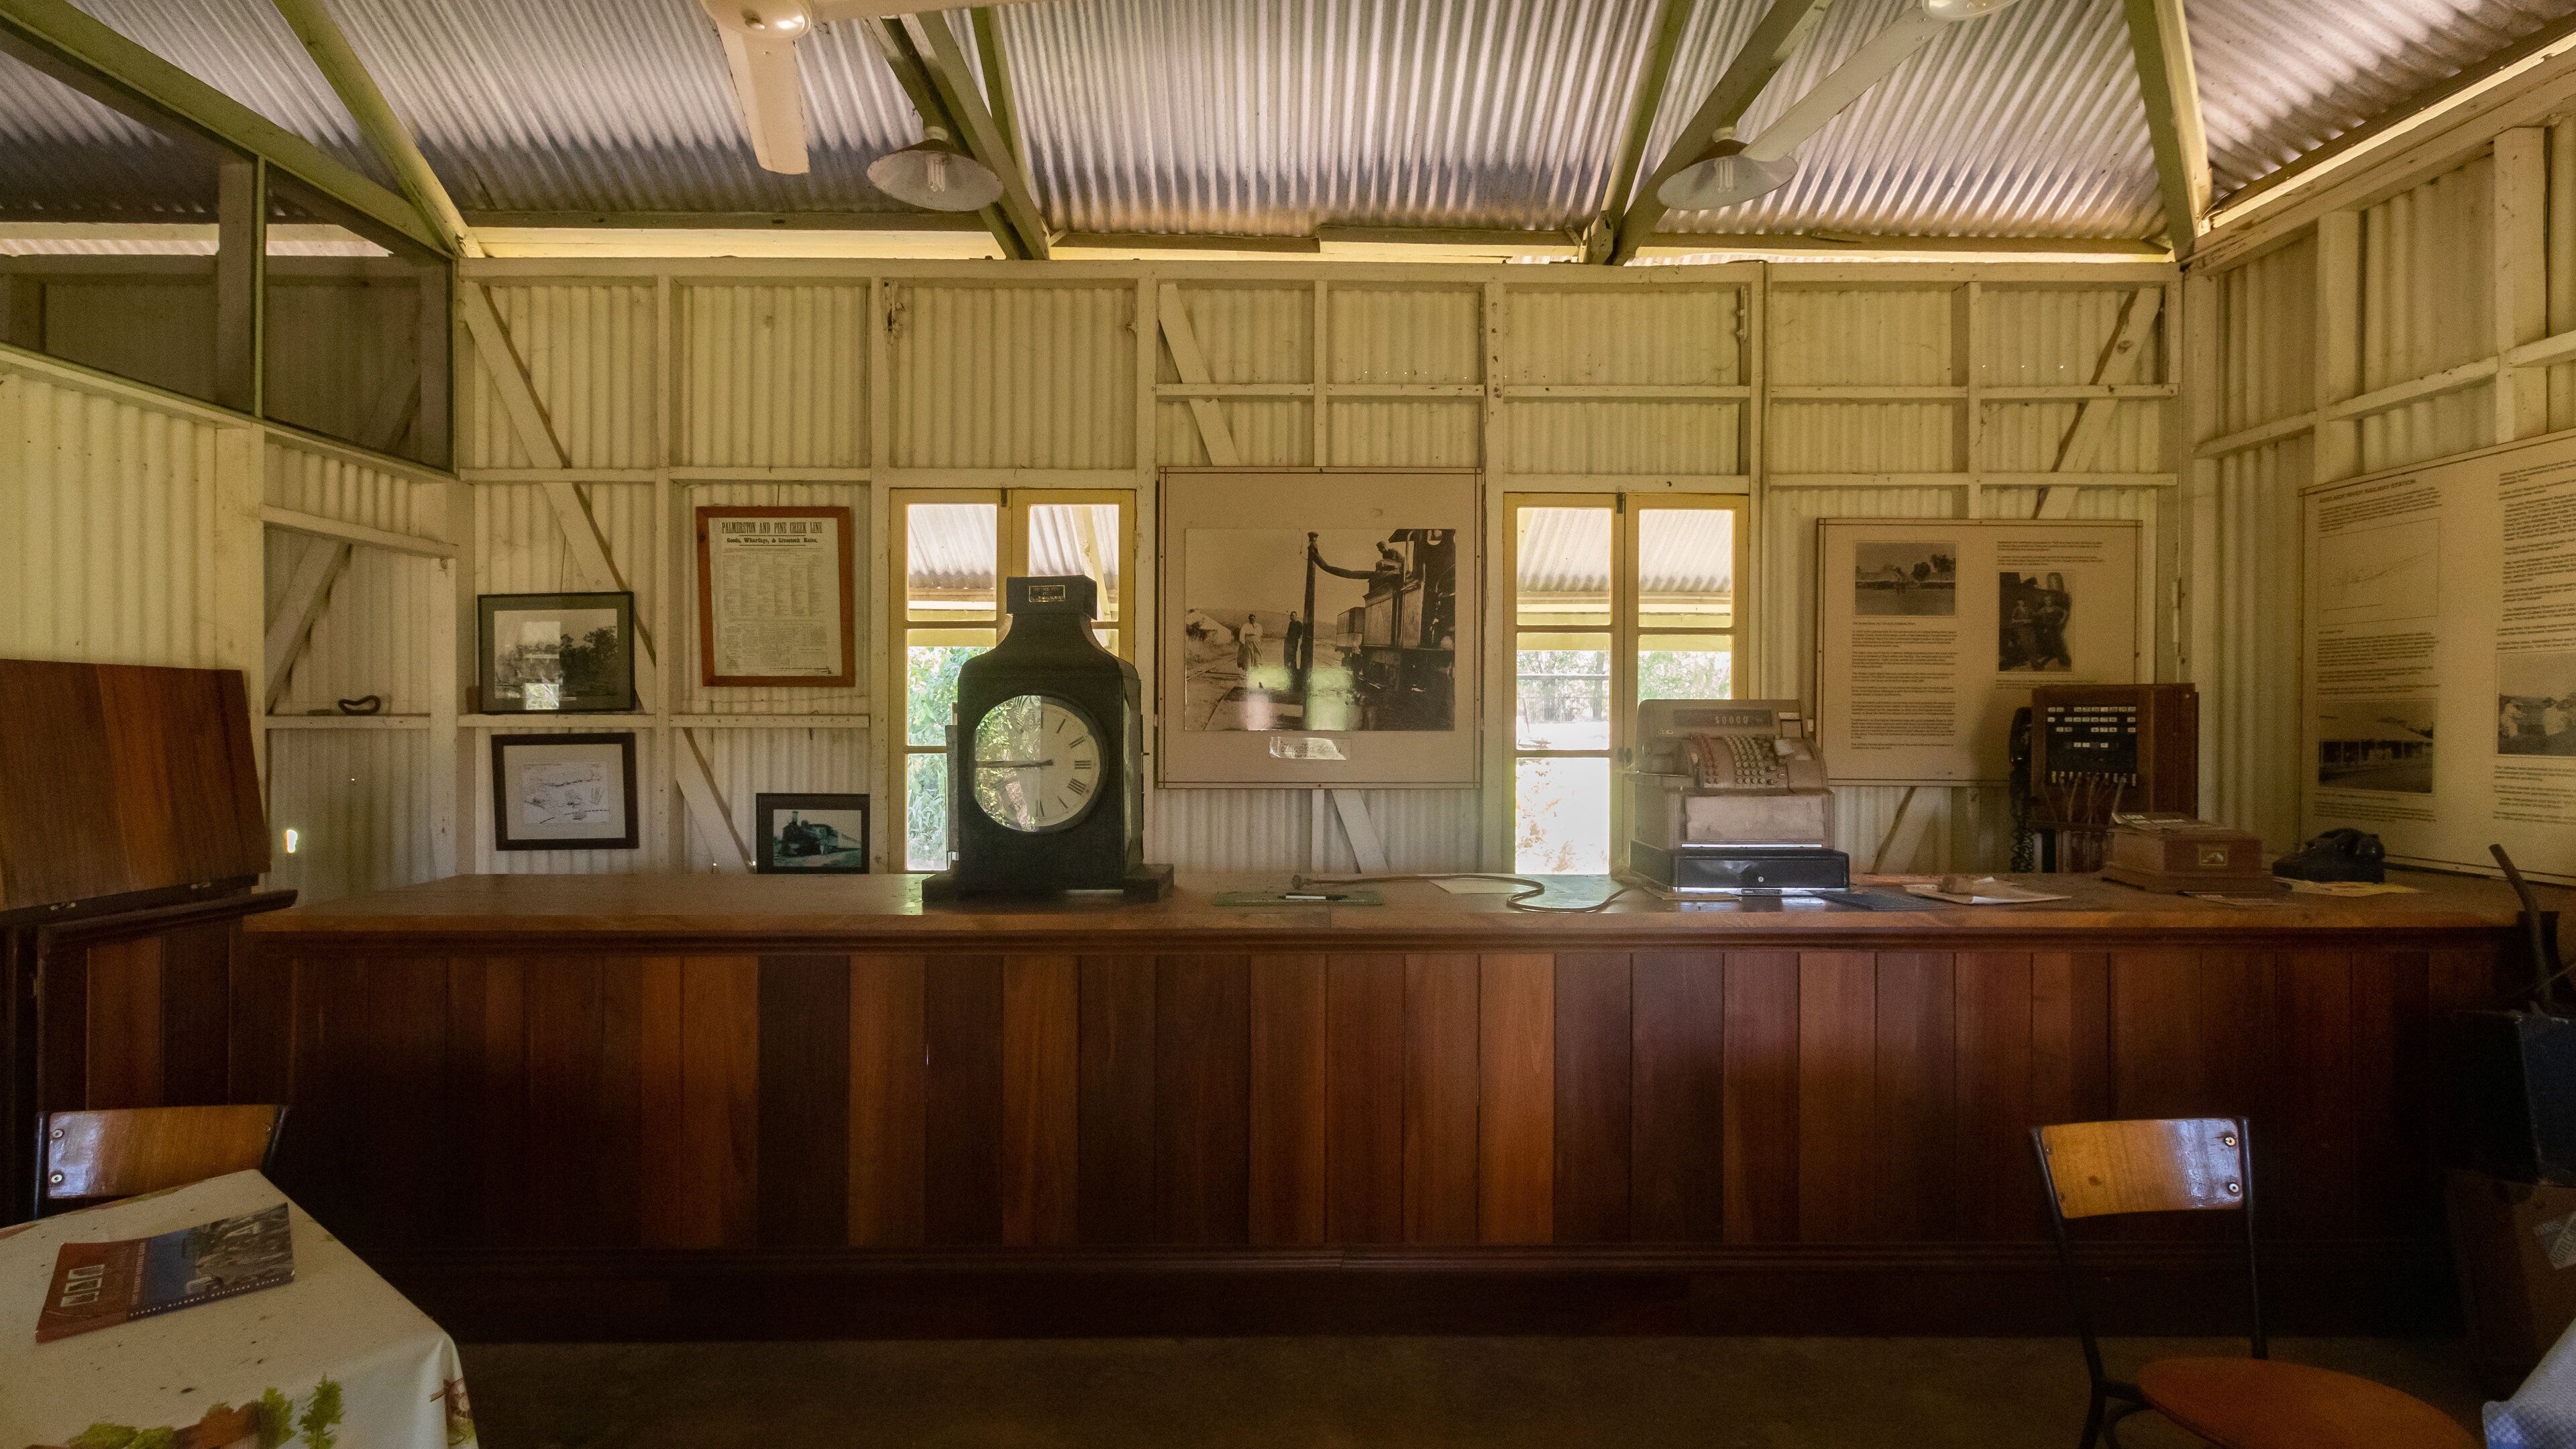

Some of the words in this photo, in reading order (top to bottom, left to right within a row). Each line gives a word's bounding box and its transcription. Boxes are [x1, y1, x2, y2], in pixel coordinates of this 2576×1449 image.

[722, 522, 756, 534] PALMERSTON
[759, 522, 771, 534] AND
[774, 522, 787, 534] PINE
[790, 522, 807, 534] CREEK
[810, 522, 823, 534] LINE
